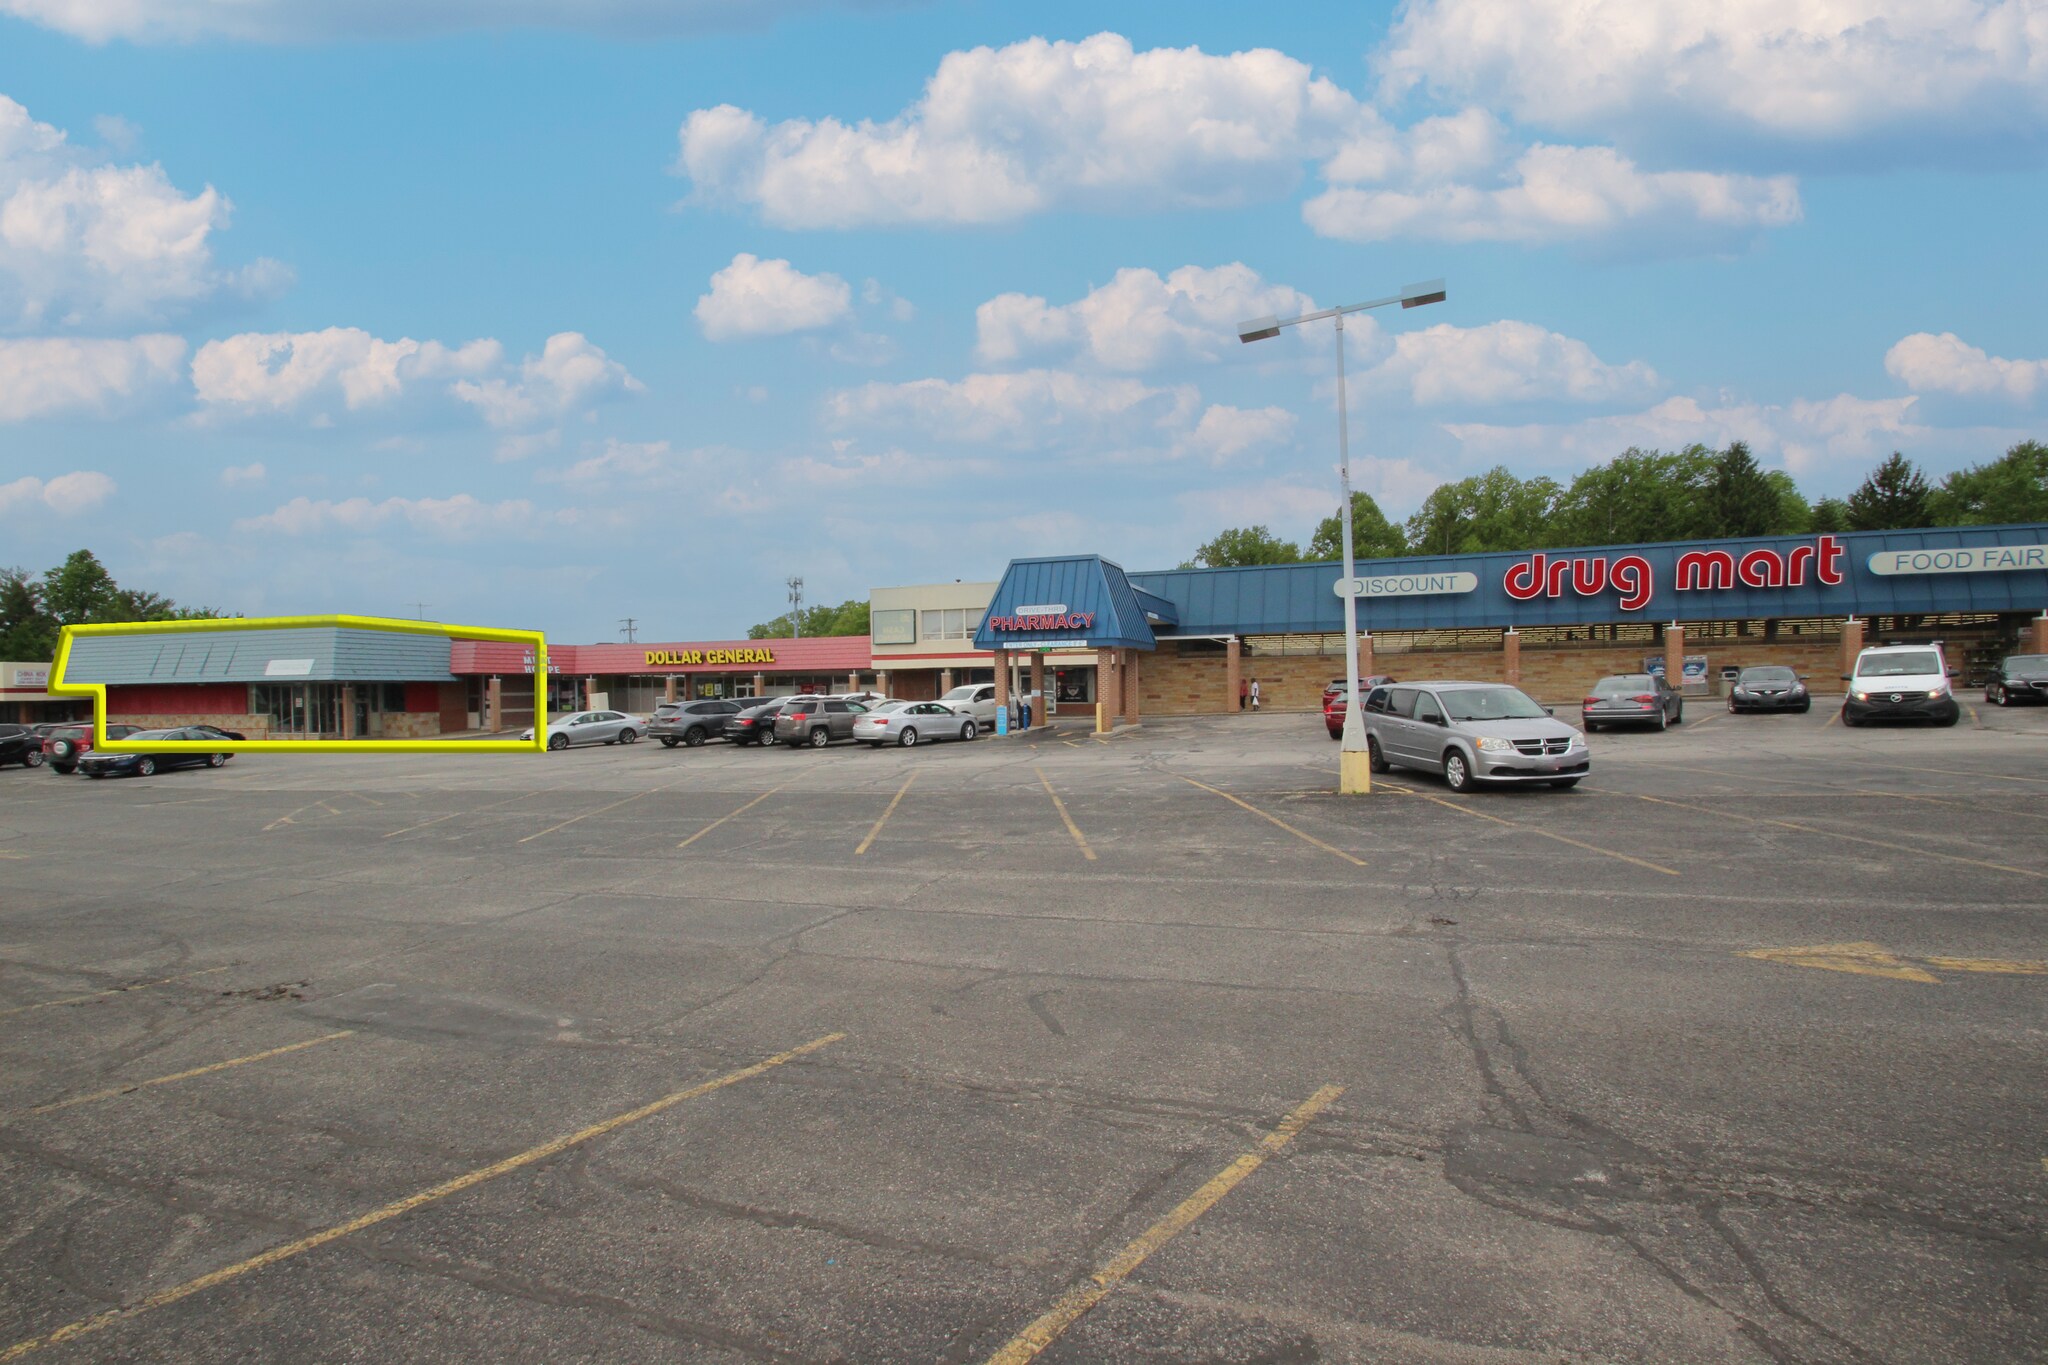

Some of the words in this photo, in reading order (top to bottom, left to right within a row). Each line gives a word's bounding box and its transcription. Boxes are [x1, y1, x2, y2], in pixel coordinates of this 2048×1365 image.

[1895, 552, 1973, 571] FOOD
[1983, 548, 2045, 567] FAIR
[1503, 554, 1653, 611] drug
[1675, 535, 1844, 591] mart
[989, 612, 1095, 631] PHARMACY
[644, 650, 703, 665] DOLLAR
[706, 648, 775, 664] GENERAL
